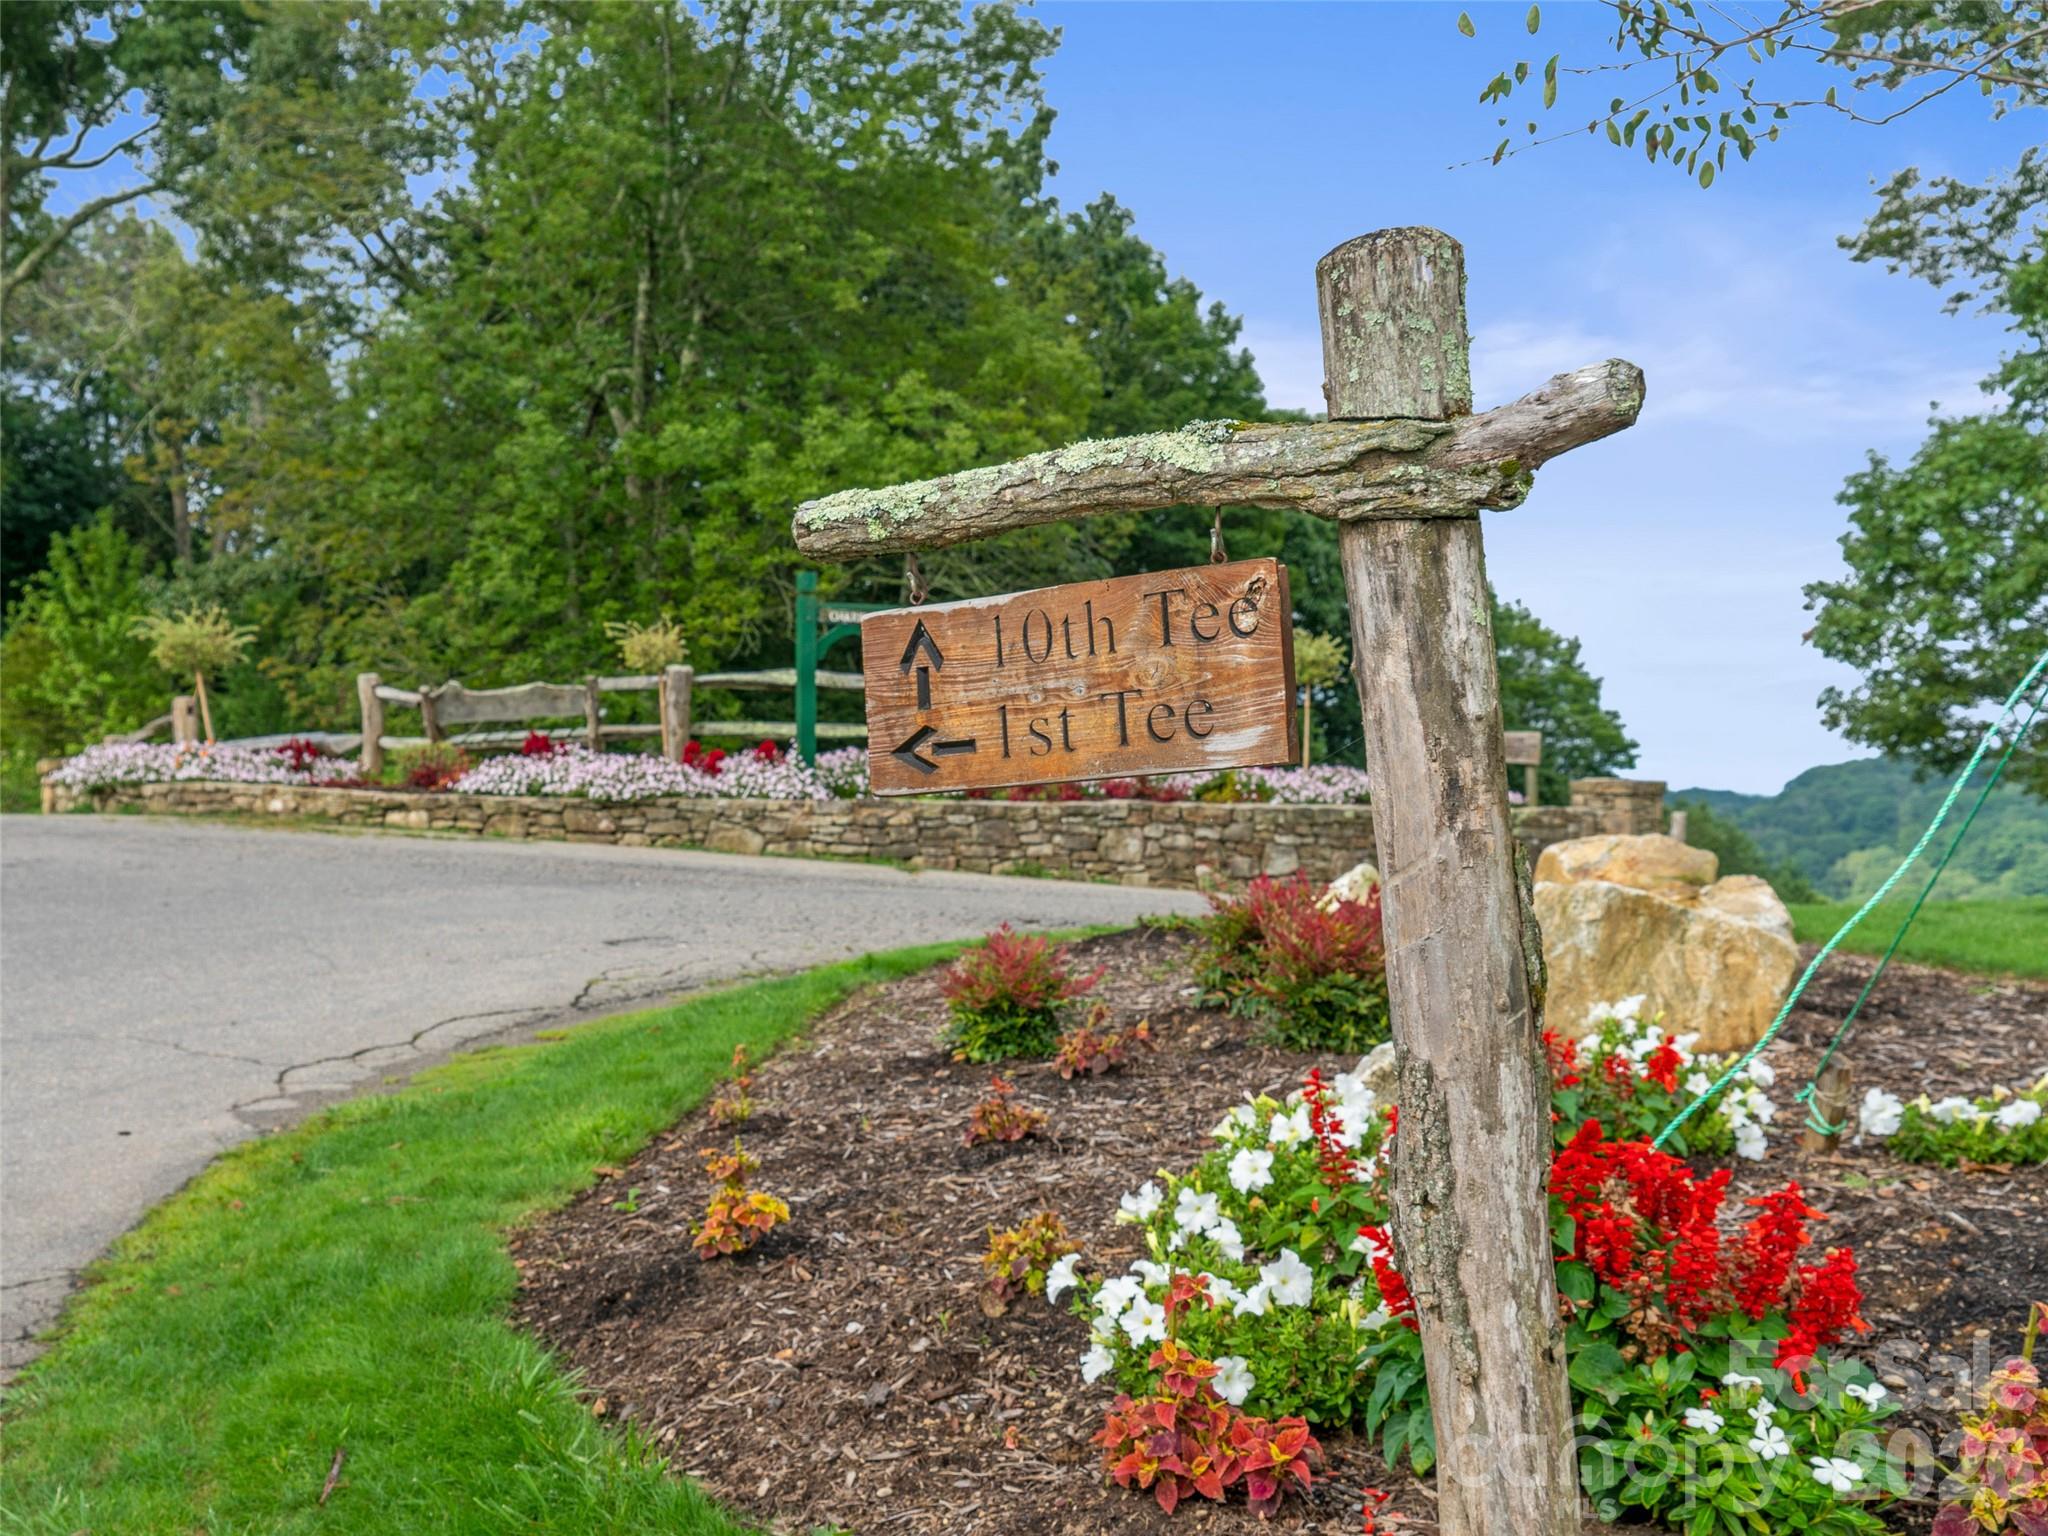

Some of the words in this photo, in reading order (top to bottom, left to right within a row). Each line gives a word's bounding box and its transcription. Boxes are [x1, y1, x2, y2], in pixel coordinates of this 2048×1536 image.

[993, 600, 1119, 668] 10th
[1143, 588, 1260, 648] Tee
[997, 703, 1076, 759] 1st
[1100, 688, 1216, 748] Tee
